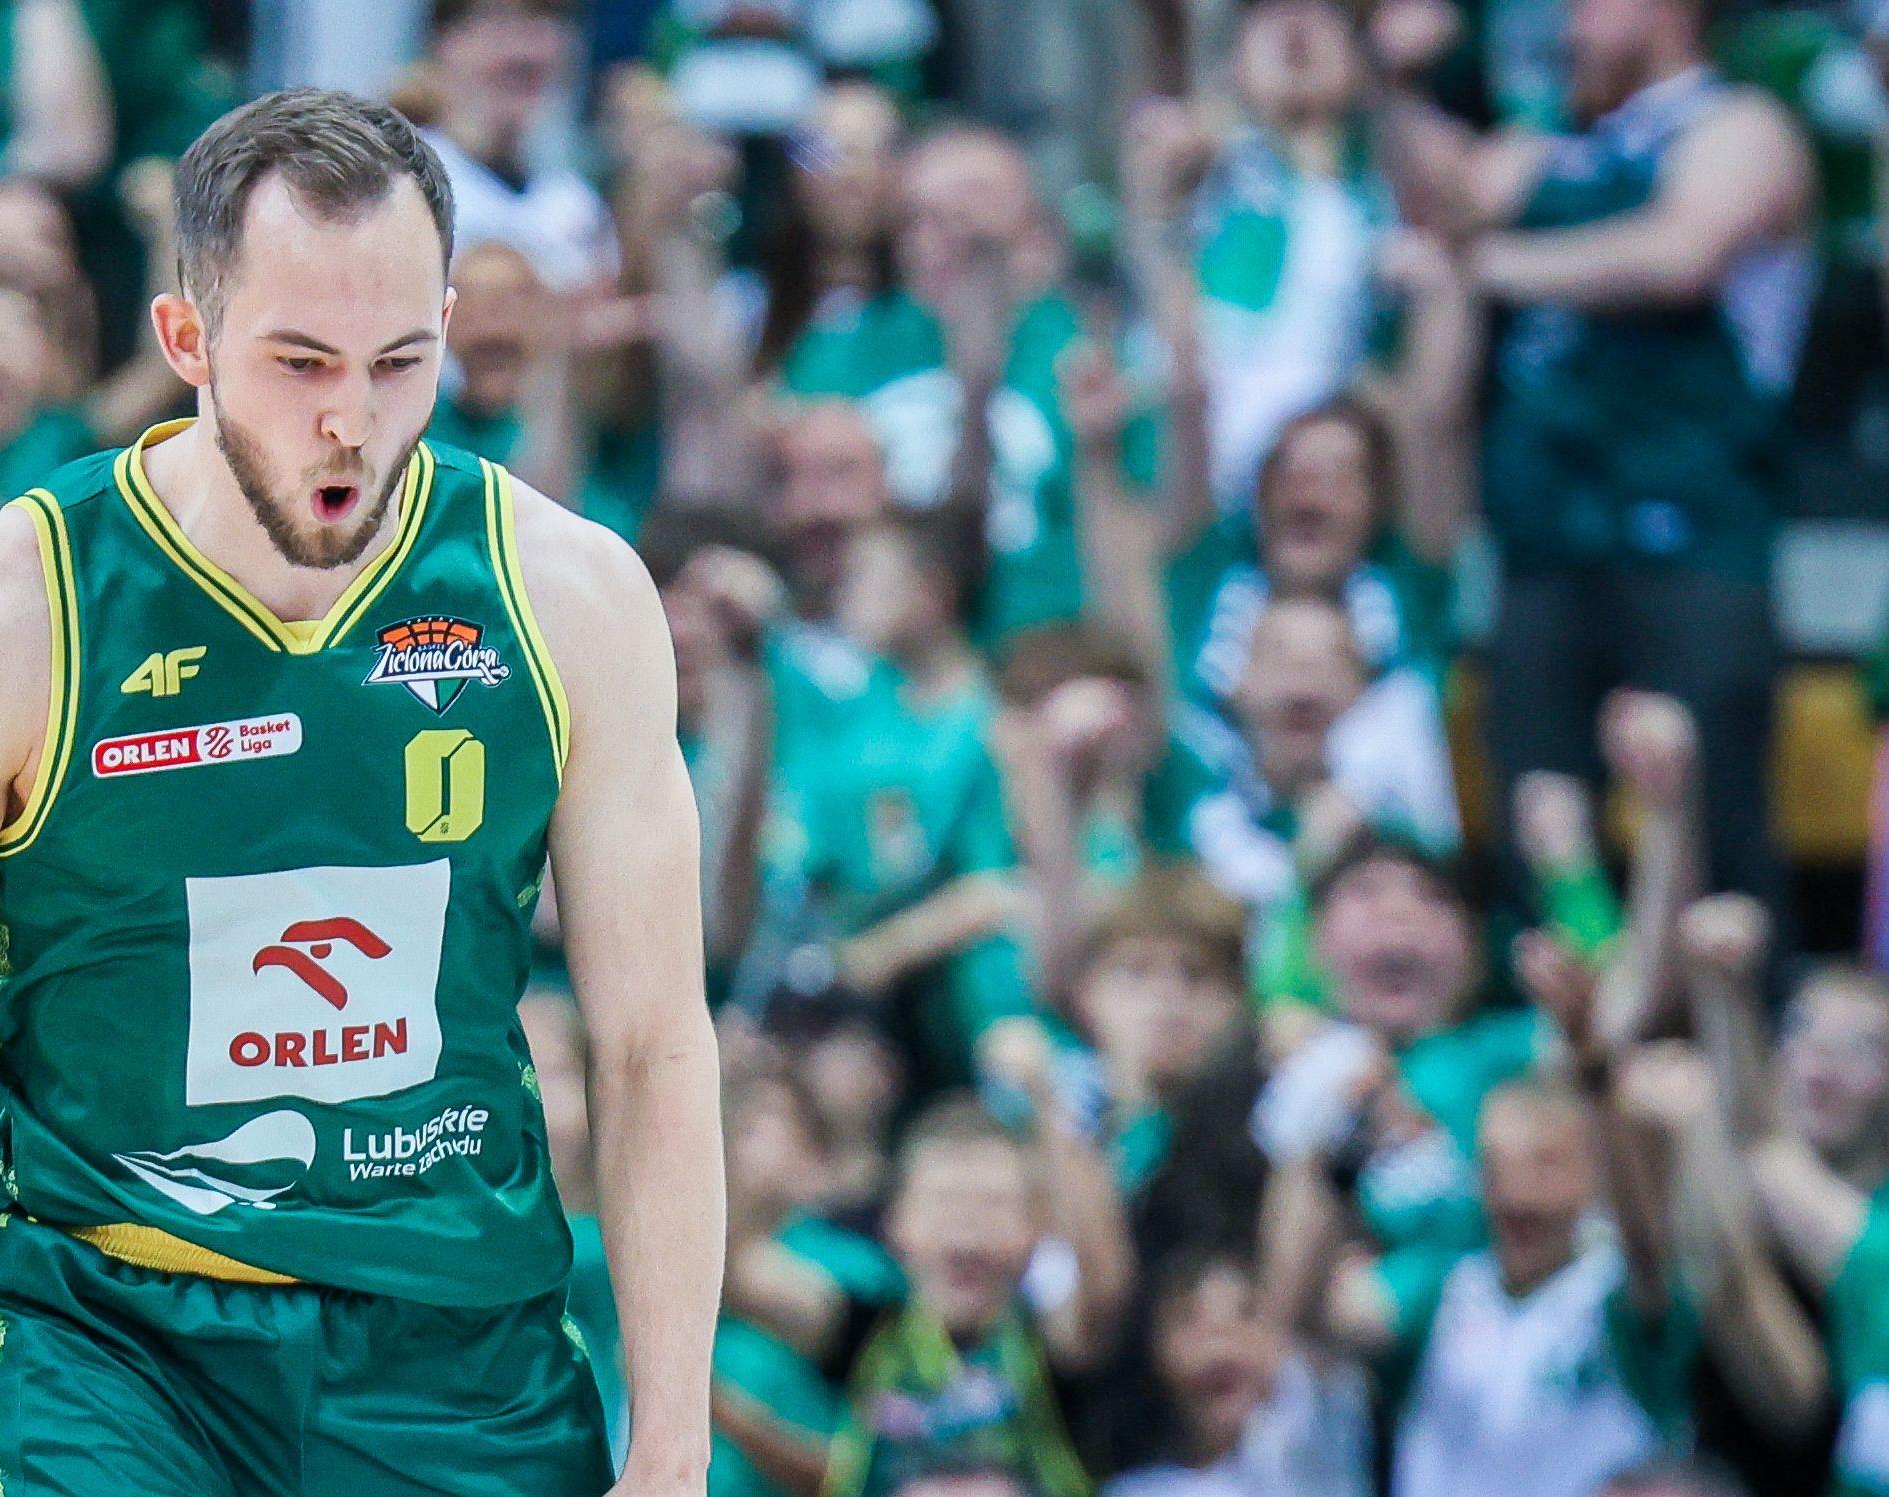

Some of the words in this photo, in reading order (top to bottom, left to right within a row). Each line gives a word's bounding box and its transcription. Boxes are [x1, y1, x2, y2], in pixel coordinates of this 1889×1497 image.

[121, 646, 207, 697] 4F
[239, 719, 291, 738] Basket
[240, 737, 272, 754] Liga
[102, 737, 190, 768] ORLEN
[404, 728, 485, 843] 0
[229, 1017, 408, 1068] ORLEN
[343, 1104, 489, 1161] Lubuskie
[349, 1161, 416, 1182] Warte
